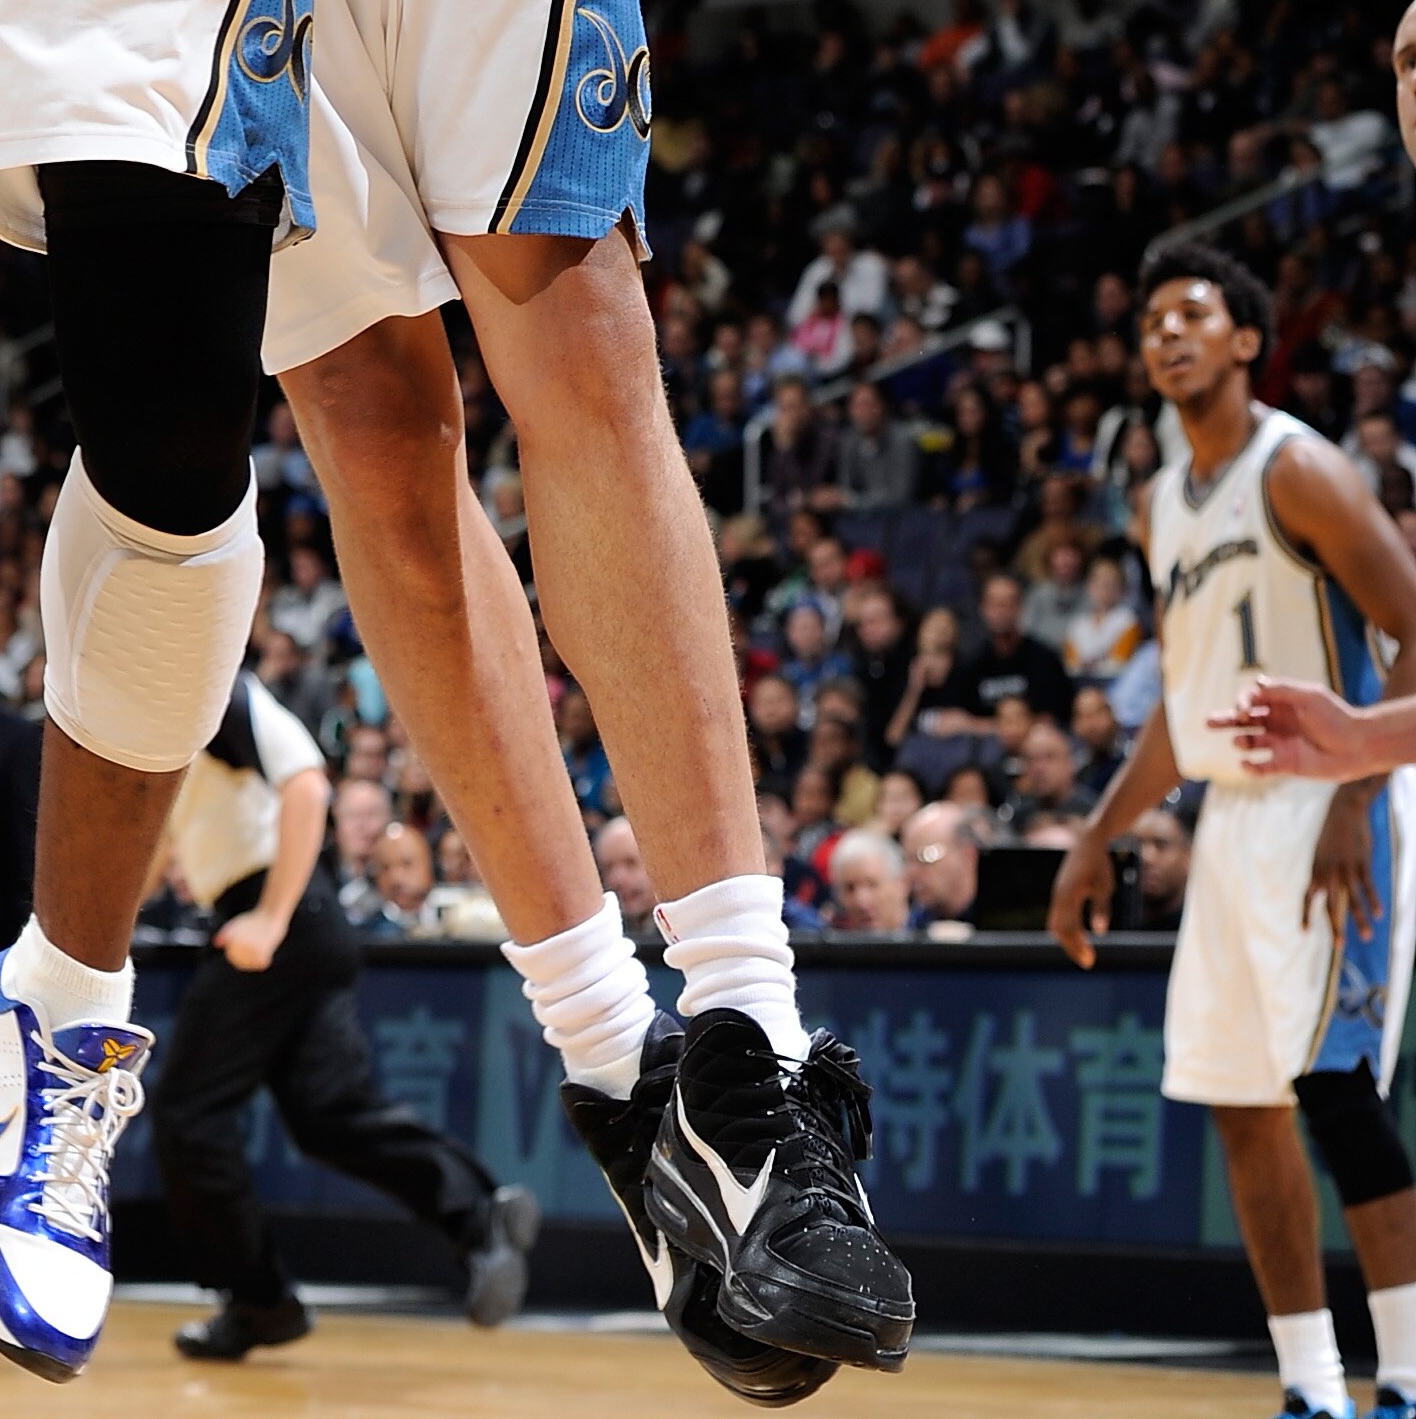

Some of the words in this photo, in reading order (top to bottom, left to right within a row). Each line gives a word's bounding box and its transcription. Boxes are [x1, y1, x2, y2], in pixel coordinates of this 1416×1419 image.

[1232, 587, 1263, 670] 1
[809, 1007, 1166, 1201] 特体育
